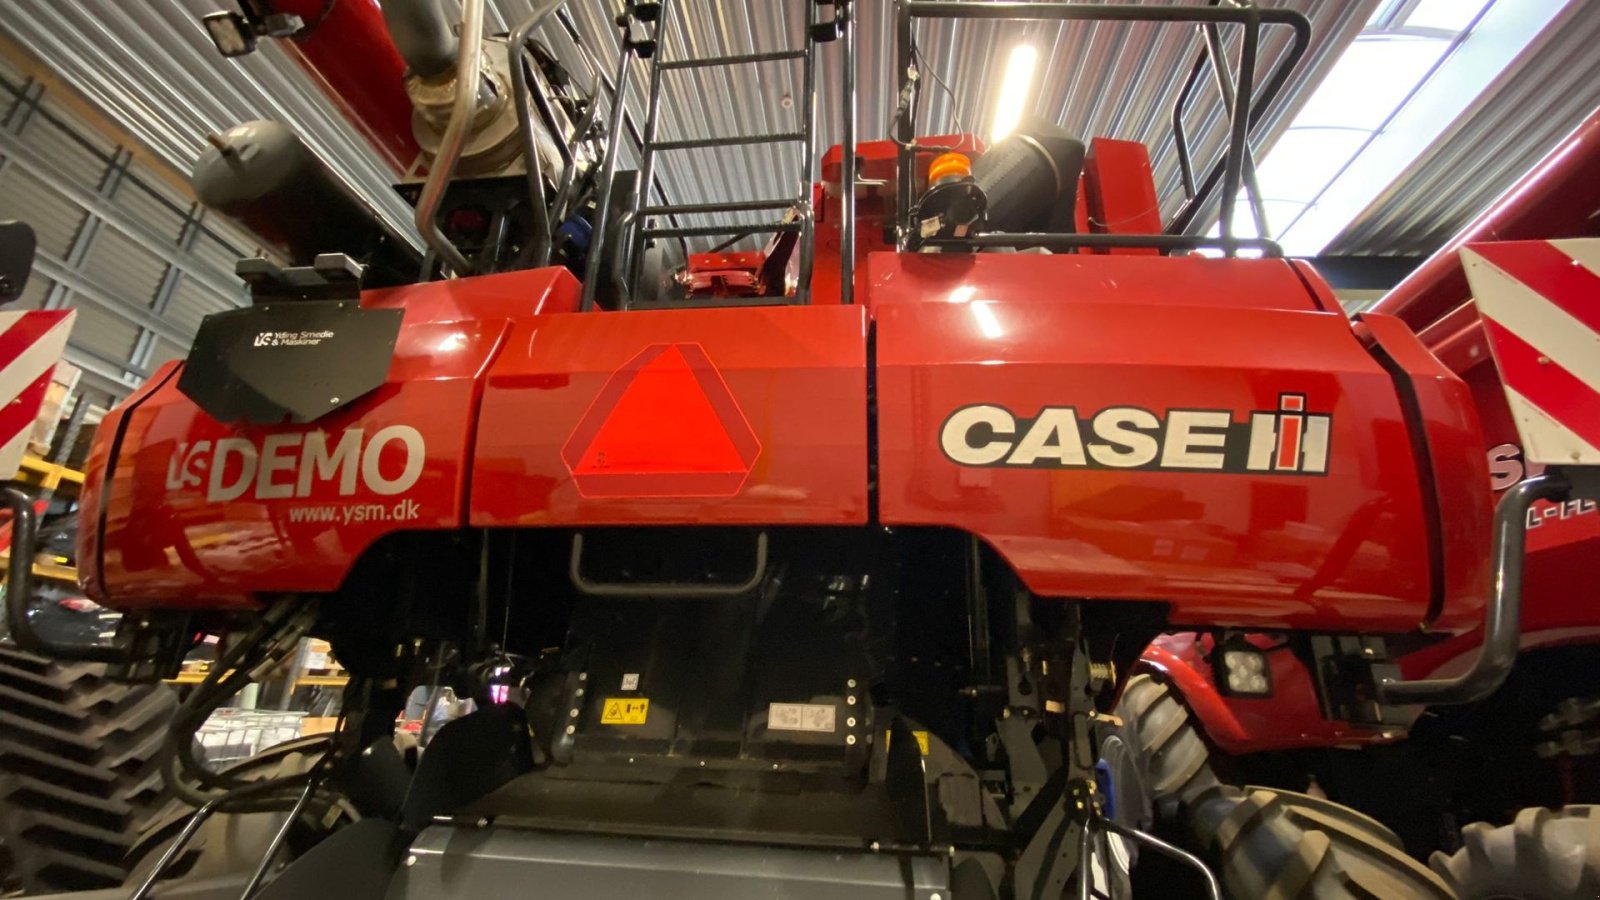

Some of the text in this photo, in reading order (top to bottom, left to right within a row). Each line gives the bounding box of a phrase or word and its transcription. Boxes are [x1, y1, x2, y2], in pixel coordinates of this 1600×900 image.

[274, 330, 335, 340] Yding Smedie
[280, 338, 321, 346] Maskiner
[941, 405, 1231, 469] CASE
[207, 425, 426, 504] DEMO
[289, 499, 421, 526] www.ysm.dk
